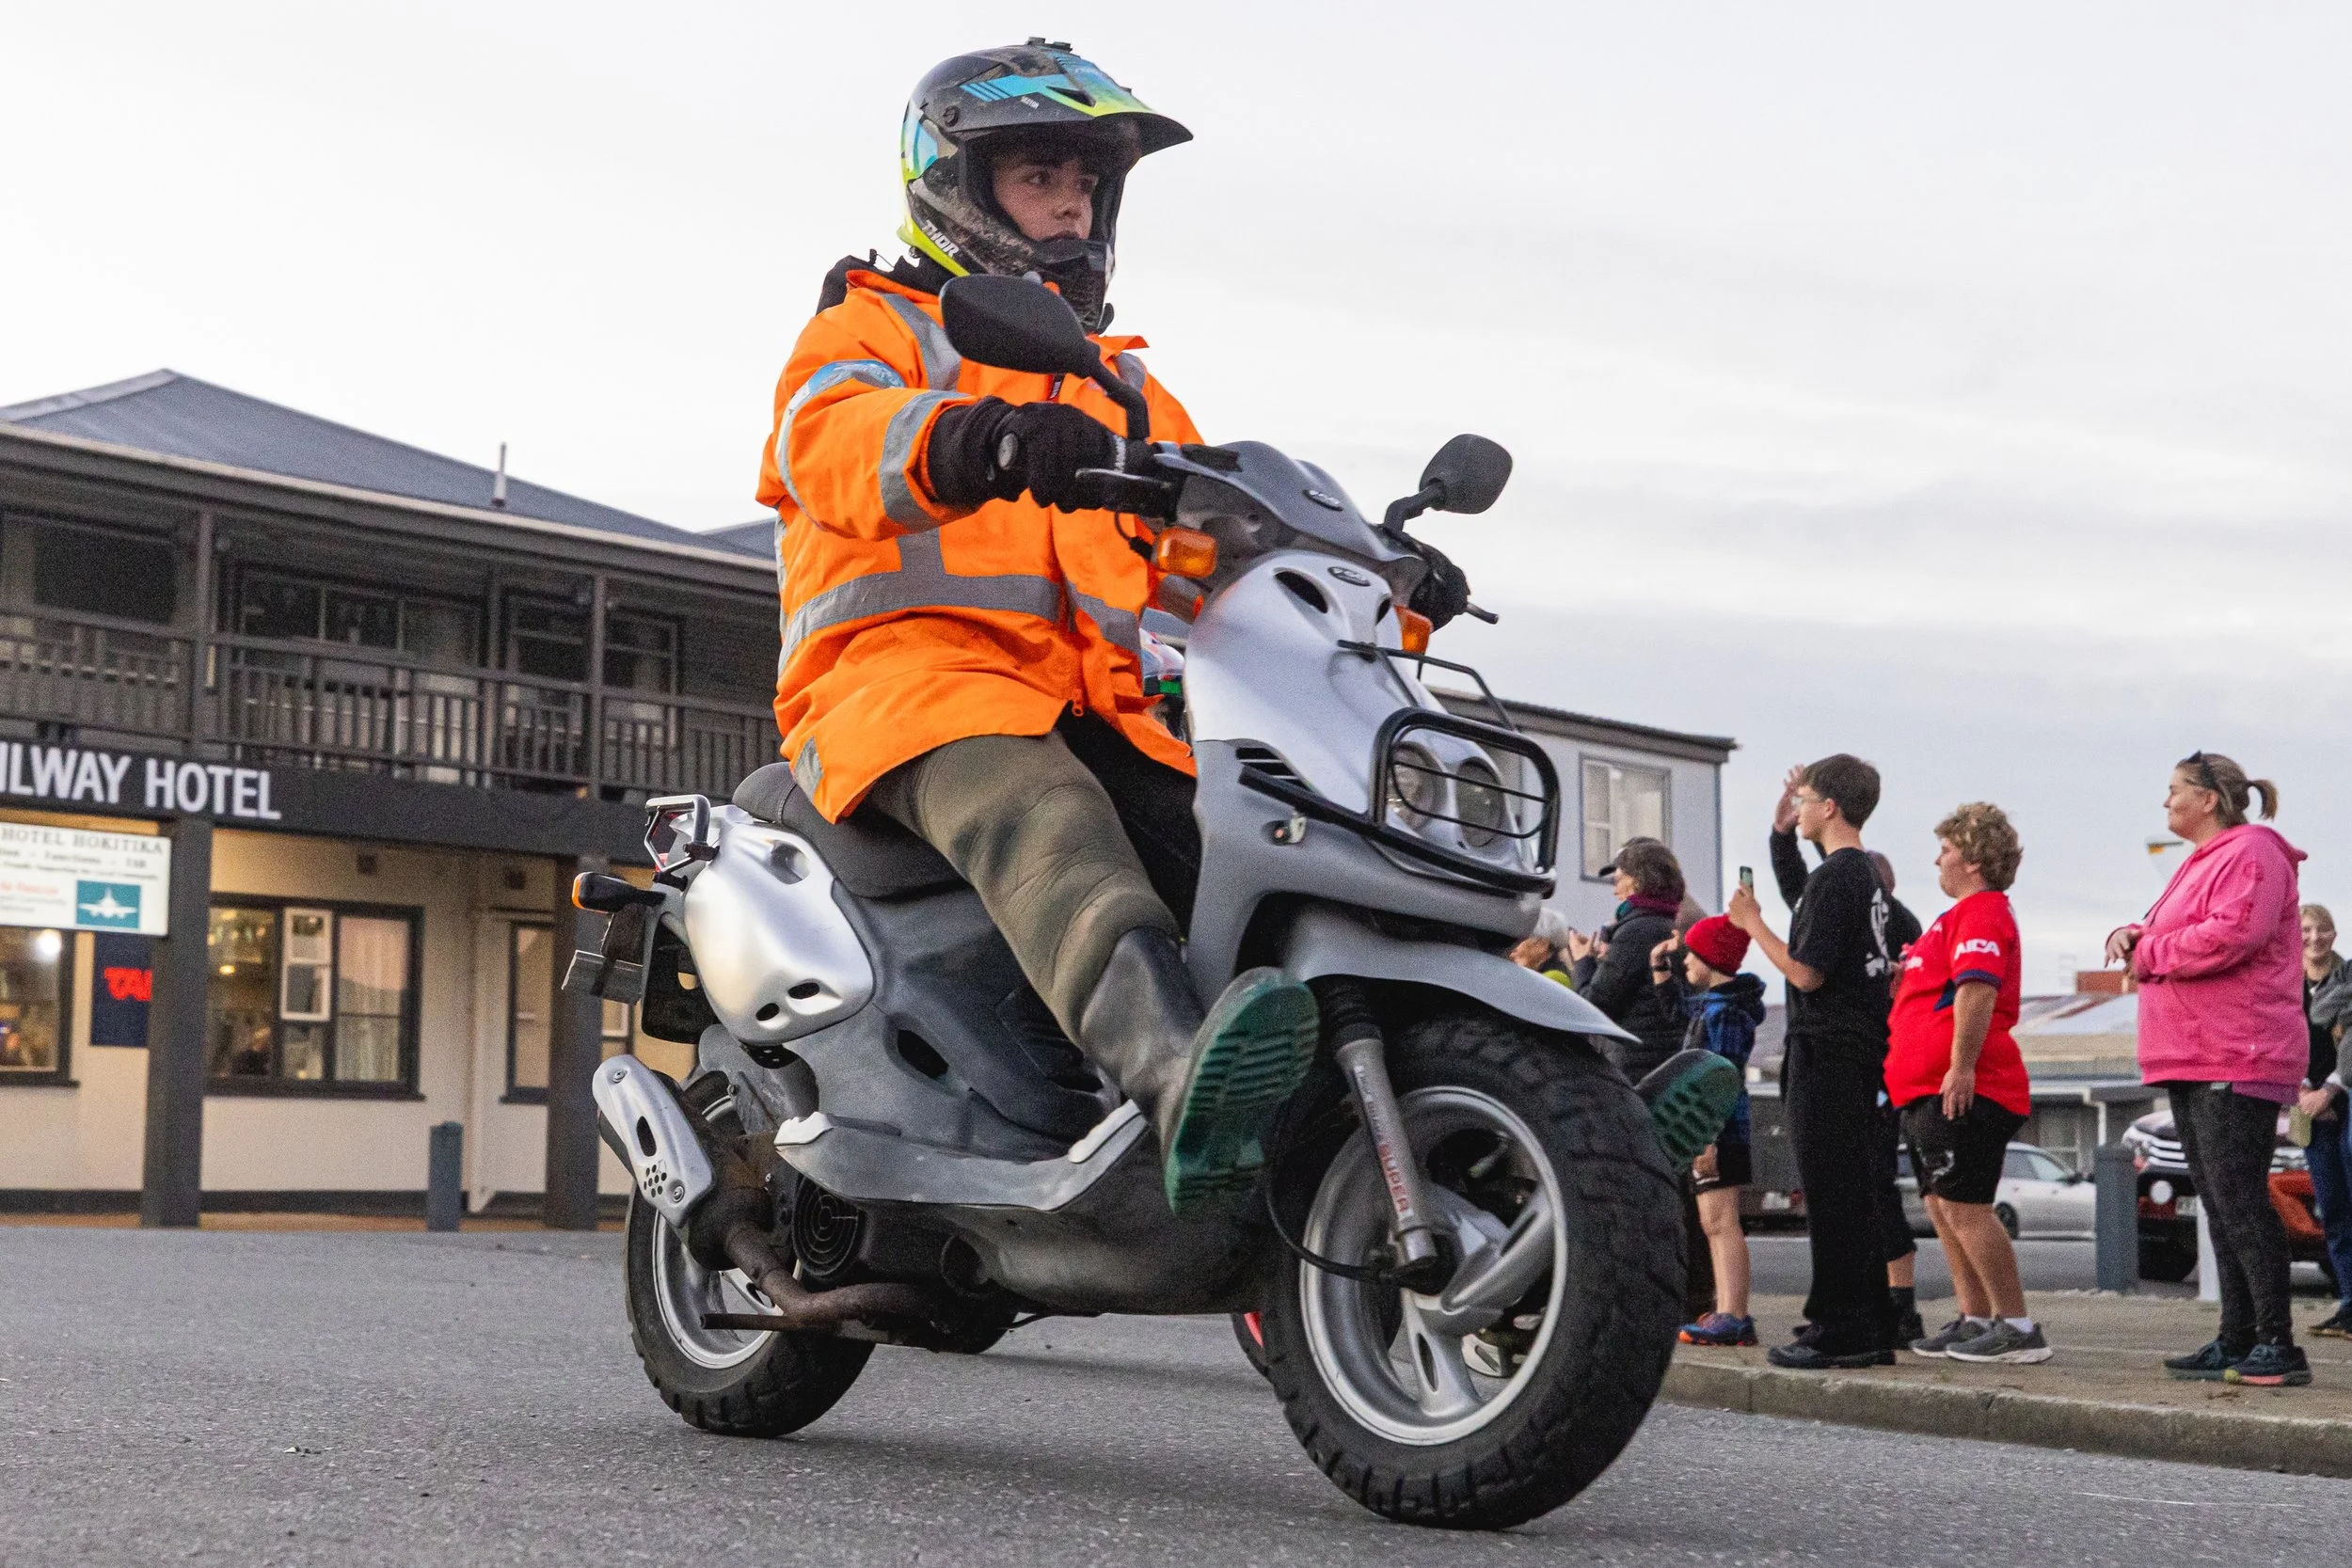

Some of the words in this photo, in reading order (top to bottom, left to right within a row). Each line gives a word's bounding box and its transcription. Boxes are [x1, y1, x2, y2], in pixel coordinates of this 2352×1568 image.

[921, 219, 960, 258] THOR
[145, 758, 281, 819] HOTEL
[2, 828, 64, 846] HOTEL
[72, 833, 163, 854] HOKITIKA
